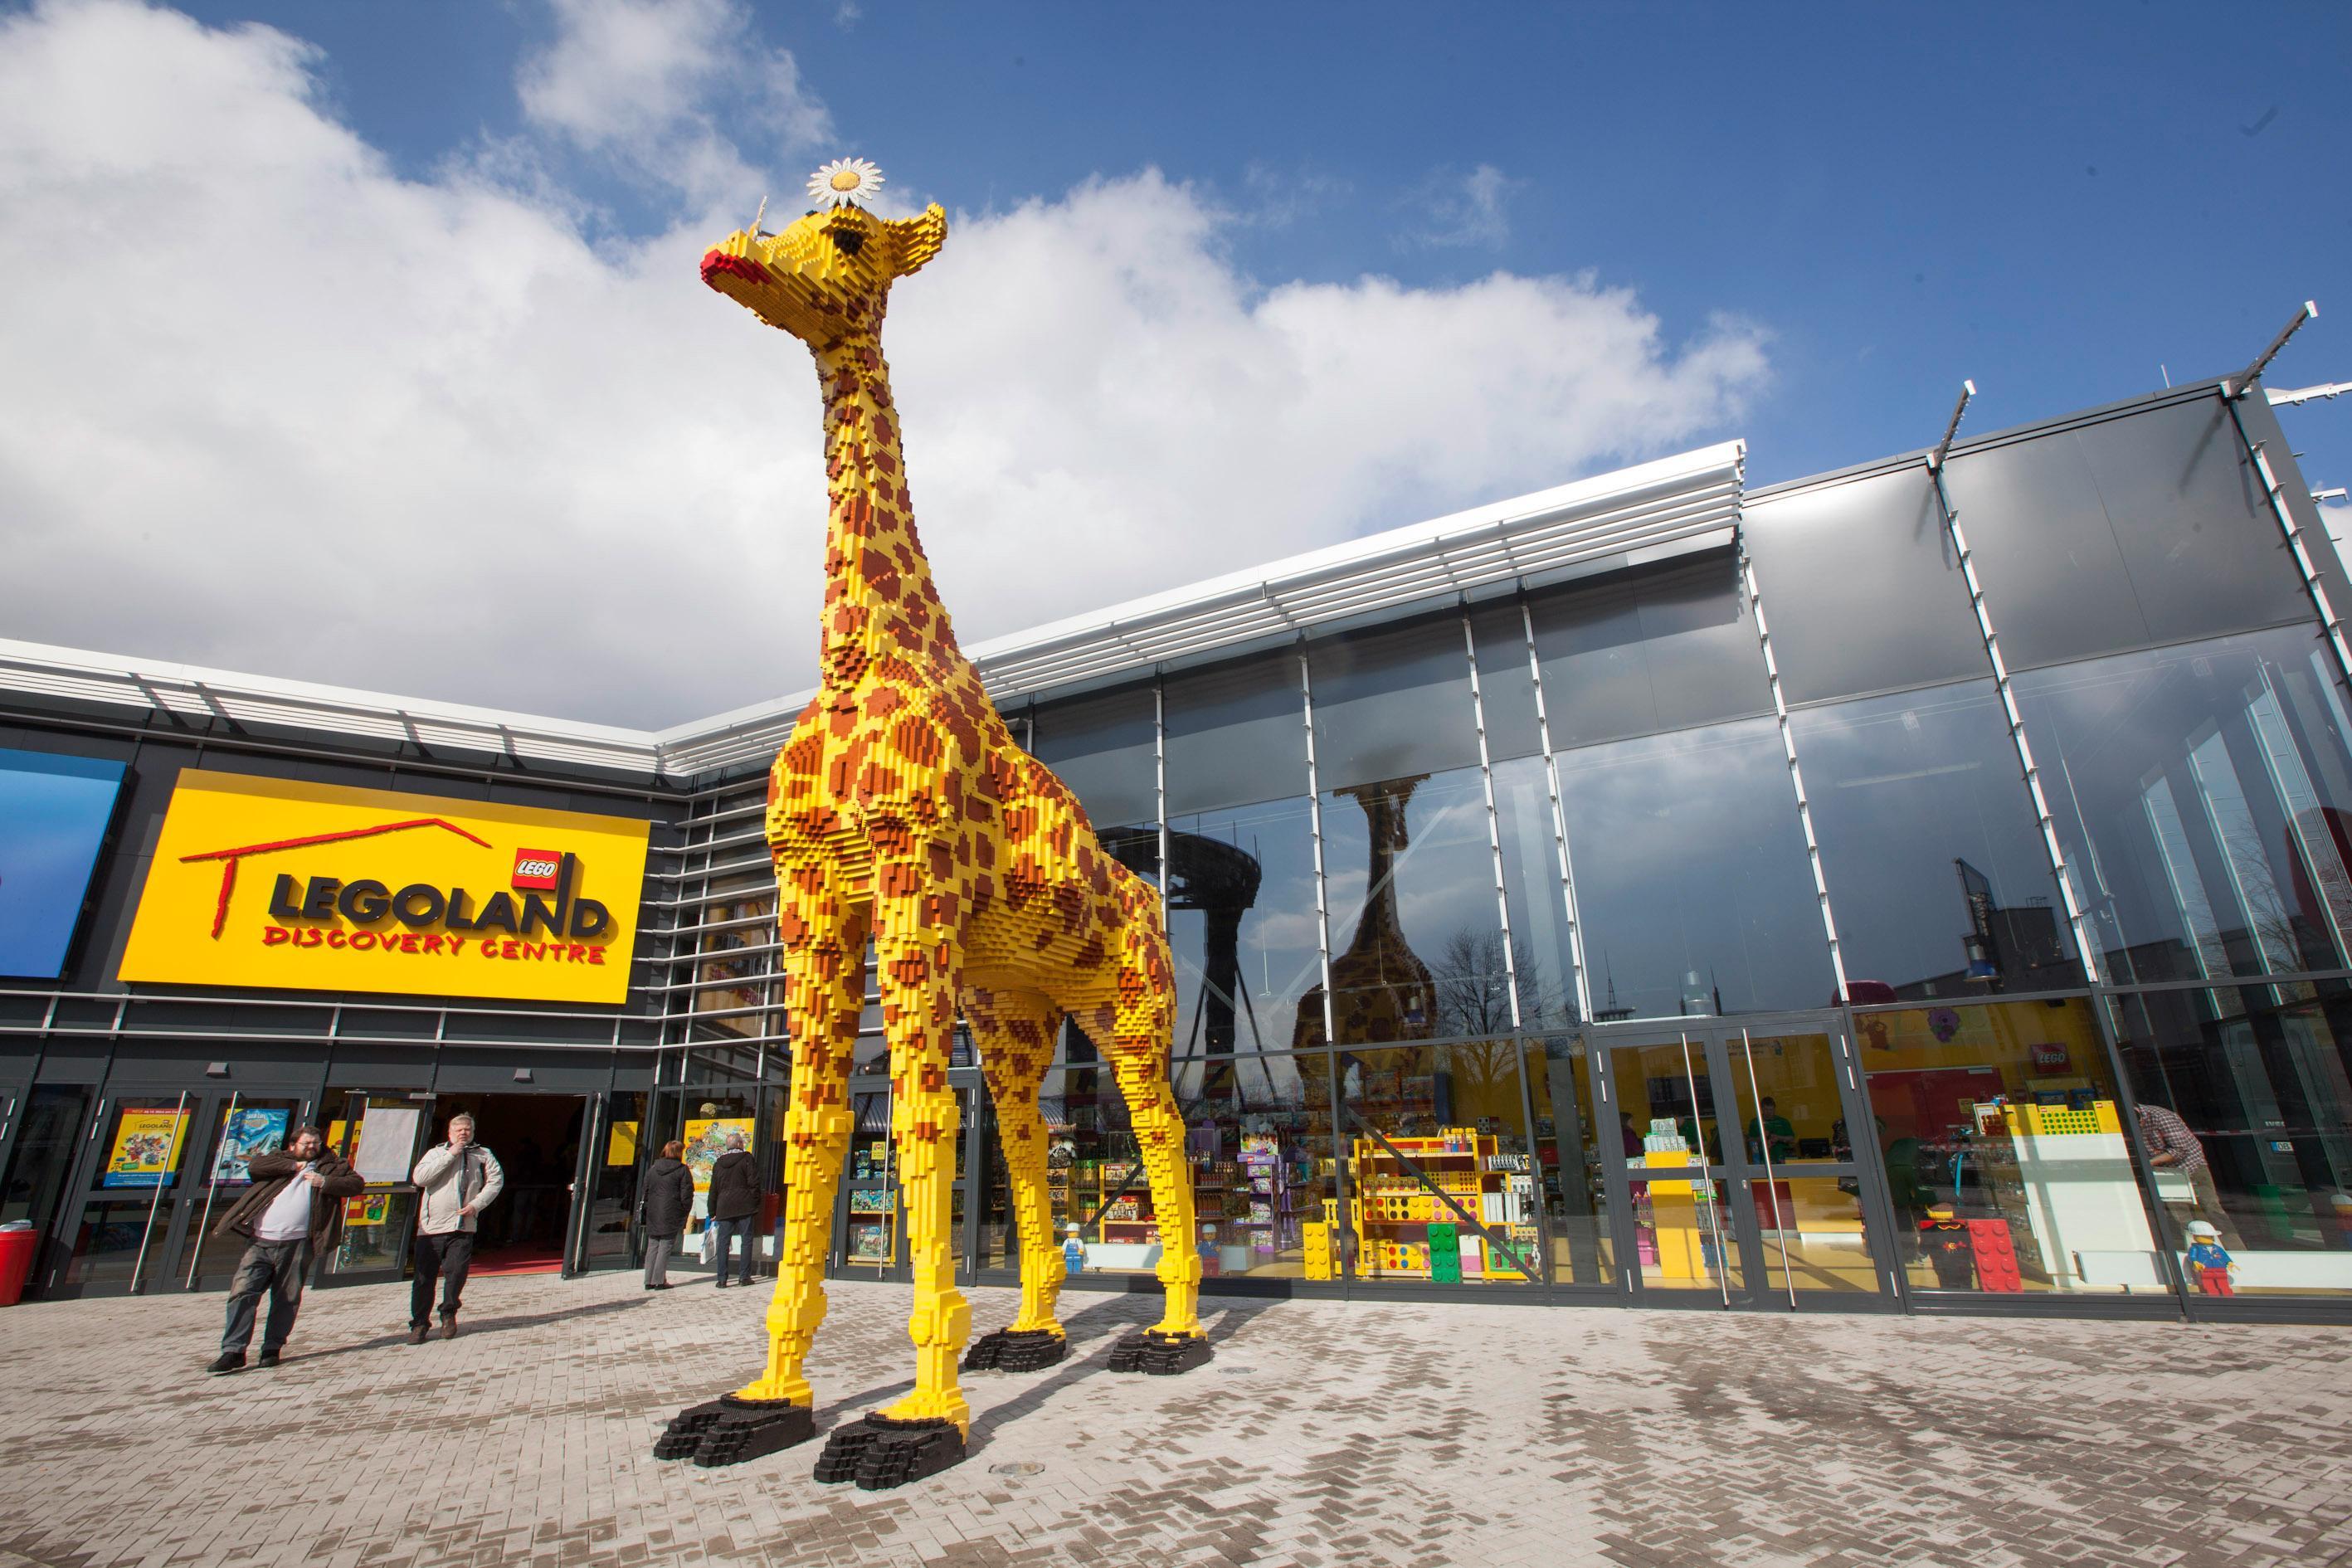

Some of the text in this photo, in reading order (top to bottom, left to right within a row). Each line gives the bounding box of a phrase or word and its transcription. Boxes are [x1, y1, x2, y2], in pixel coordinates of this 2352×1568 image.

[515, 859, 557, 878] LEGO
[268, 852, 609, 937] LEGOLAND
[262, 925, 606, 965] DISCOVERY CENTRE
[2038, 1052, 2066, 1064] LEGO
